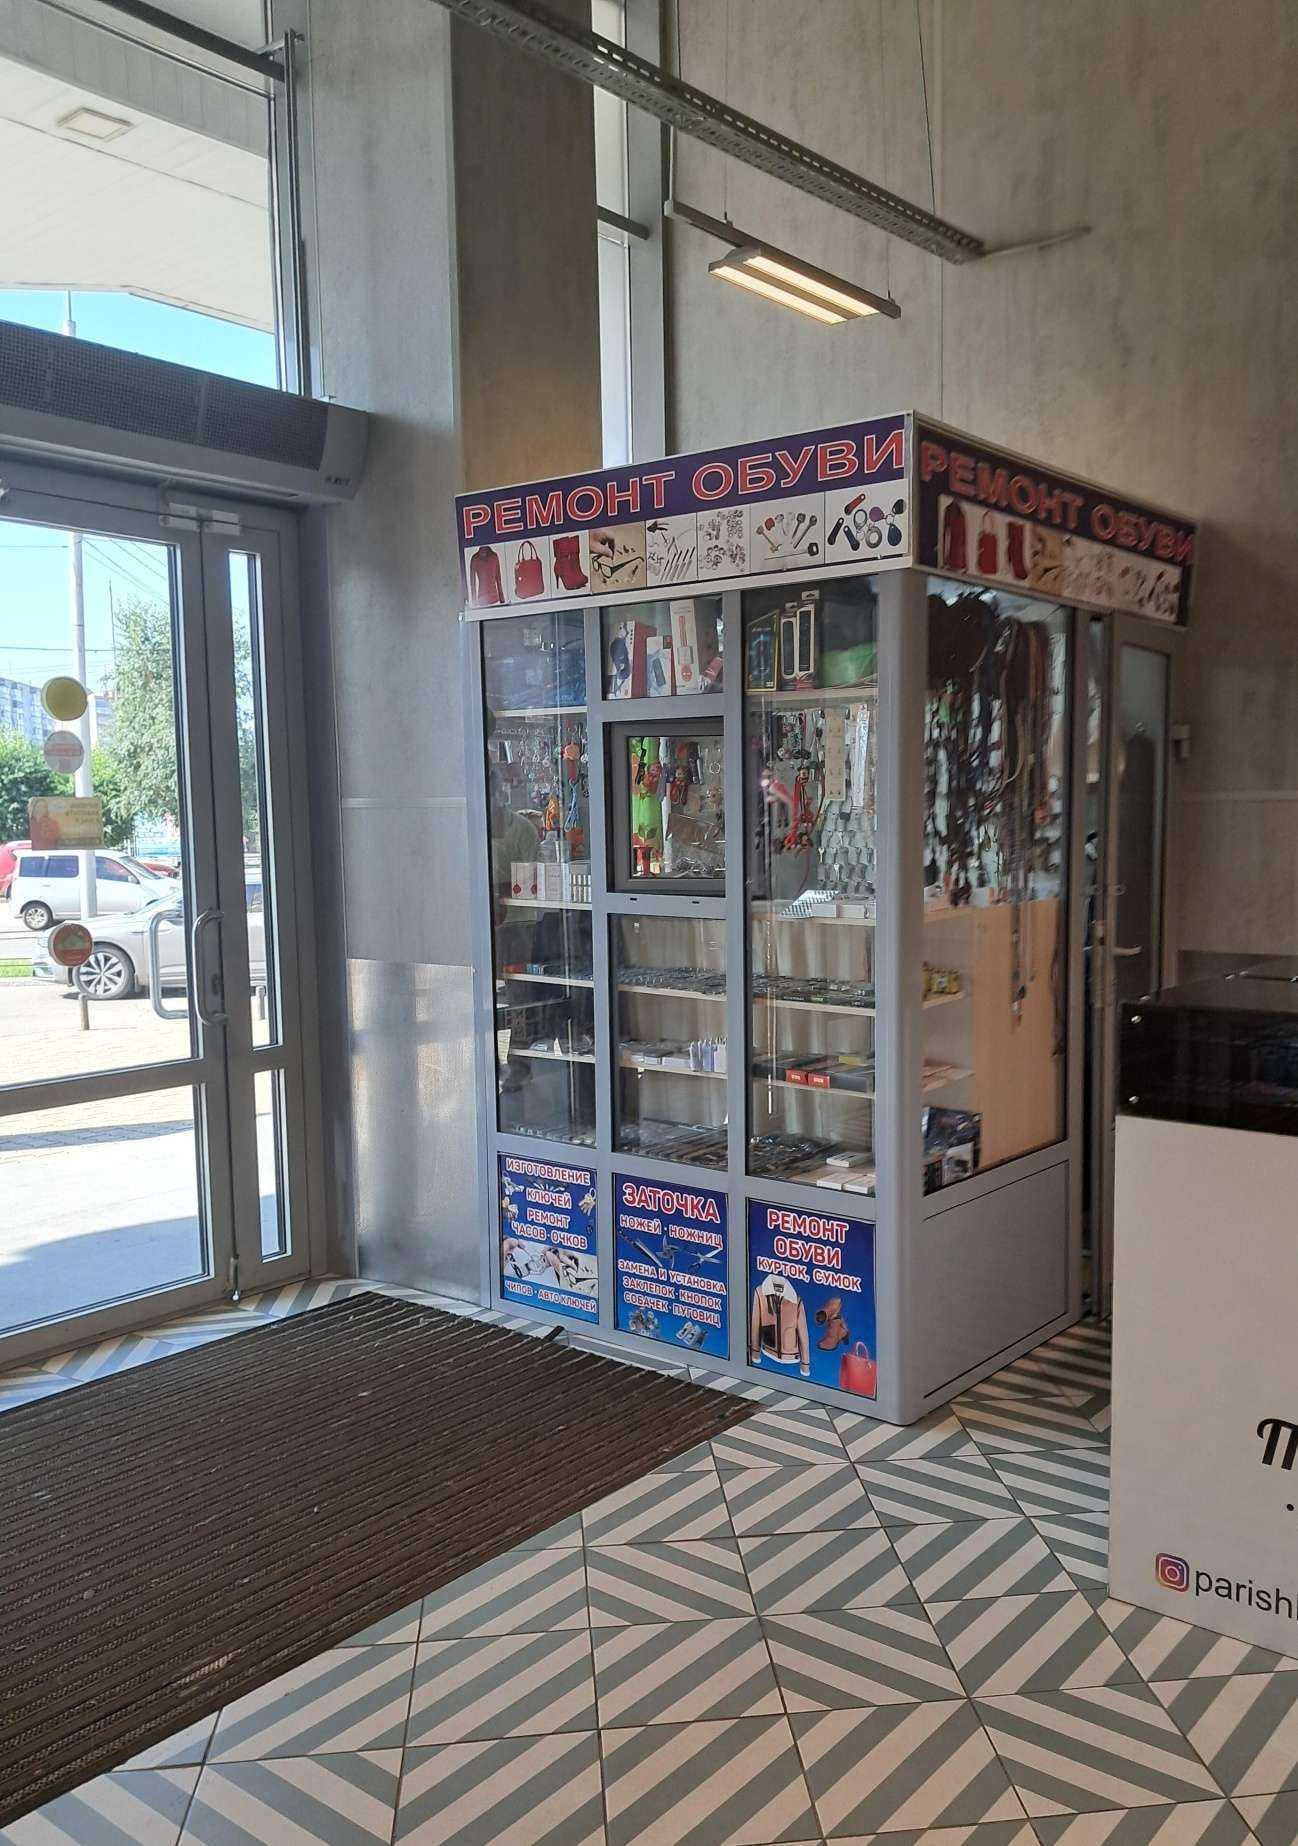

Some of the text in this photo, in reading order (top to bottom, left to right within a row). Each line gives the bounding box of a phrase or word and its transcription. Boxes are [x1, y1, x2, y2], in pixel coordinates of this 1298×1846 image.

[463, 429, 905, 539] РЕМОНТ ОБУВИ
[920, 440, 1193, 562] РЕМОНТ ОБУВИ
[506, 1158, 590, 1185] ИЗГОТОВЛЕНИЕ
[526, 1188, 572, 1209] КЛЮЧЕЙ
[622, 1183, 720, 1223] ЗАТОЧКА
[527, 1207, 570, 1229] РЕМОНТ
[619, 1214, 723, 1250] НОЖЕЙ НОЖНИЦ
[767, 1209, 849, 1243] РЕМОНТ
[511, 1222, 587, 1250] ЧАСОВ ОЧКОВ
[774, 1236, 841, 1269] ОБУВИ
[505, 1281, 533, 1296] ЧИПОВ
[618, 1259, 727, 1295] ЗАМЕНА И УСТАНОВКА
[757, 1255, 862, 1292] КУРТОК, СУМОК
[623, 1276, 722, 1311] ЗАКЛЕПОК КНОПОК
[624, 1292, 721, 1328] СОБАЧЕК ПУГОВИЦ
[1196, 1570, 1298, 1621] parish
